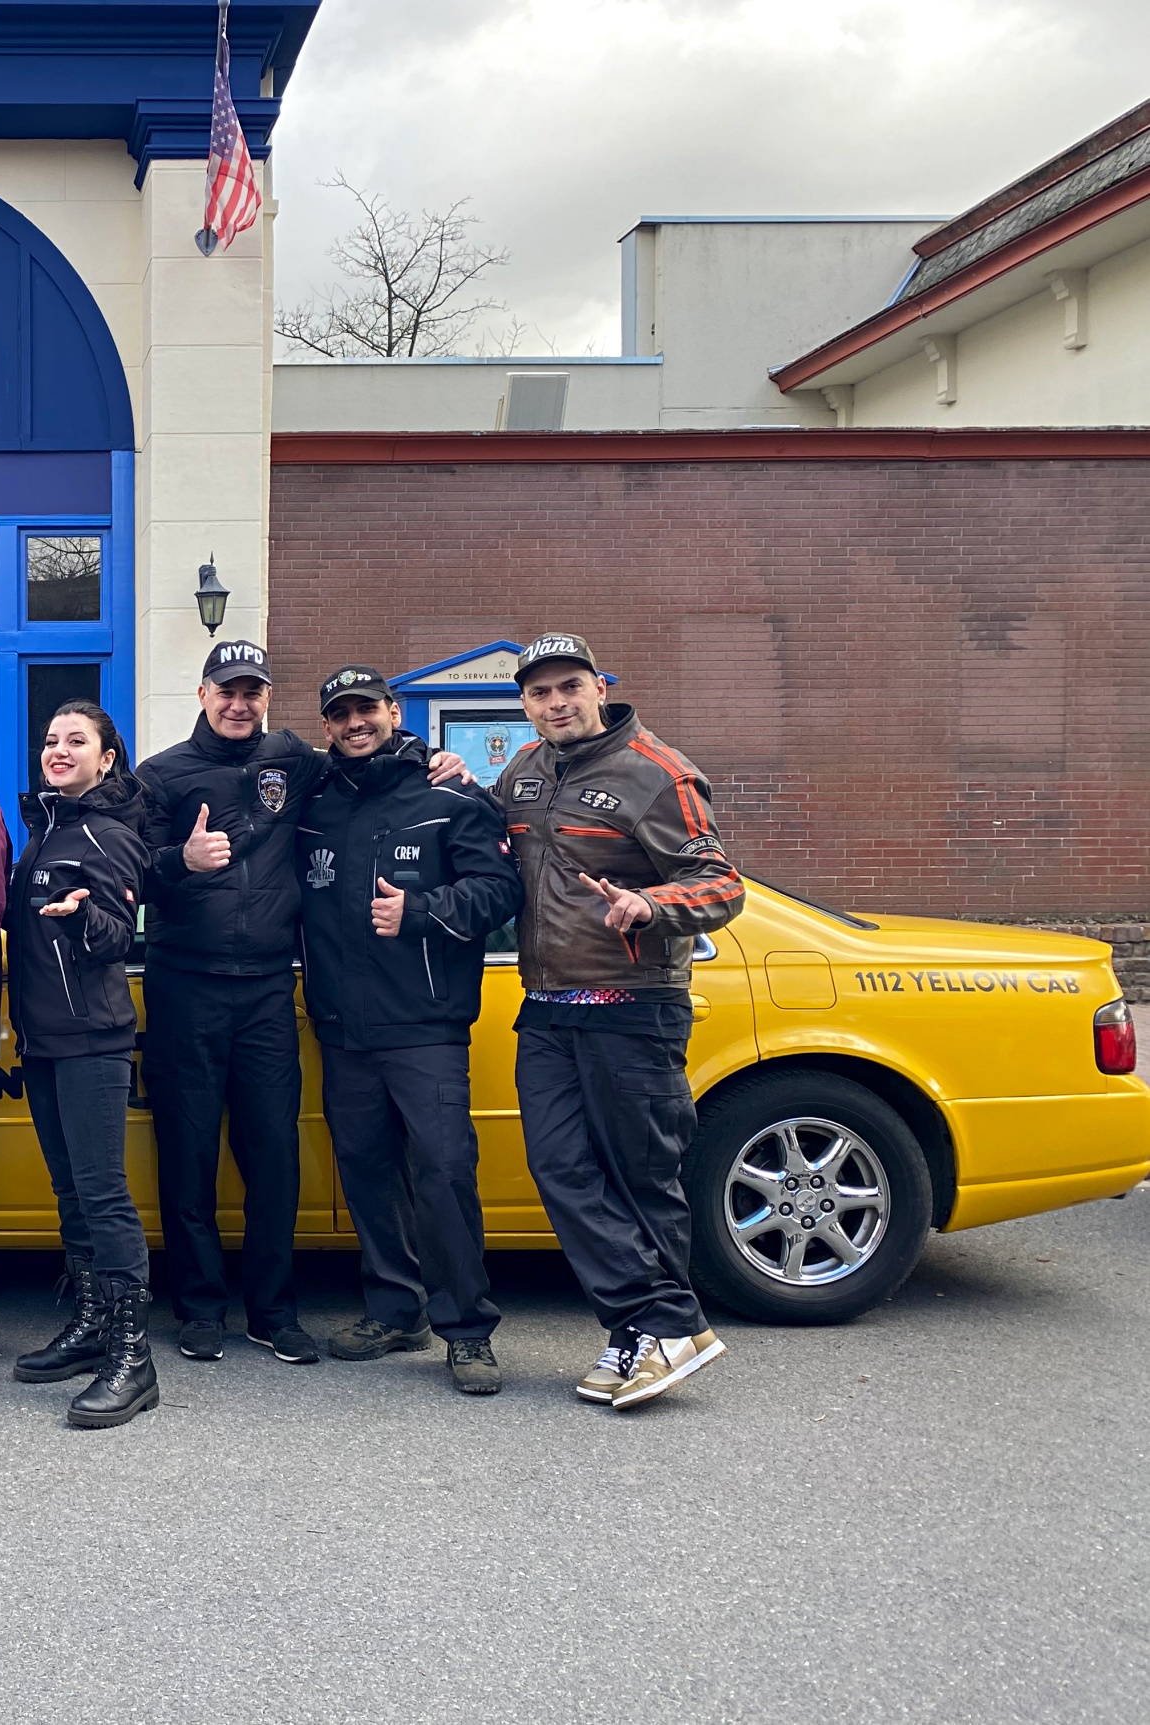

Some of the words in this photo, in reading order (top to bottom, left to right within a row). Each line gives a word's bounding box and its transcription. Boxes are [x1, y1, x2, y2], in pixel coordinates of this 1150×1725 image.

[220, 645, 264, 665] NYPD
[523, 640, 579, 661] Vans
[325, 679, 338, 692] NY
[356, 673, 372, 681] PD
[463, 672, 489, 680] SERVE
[394, 845, 421, 861] CREW
[855, 971, 904, 992] 1112
[907, 971, 1019, 993] YELLOW
[1026, 972, 1081, 994] CAB
